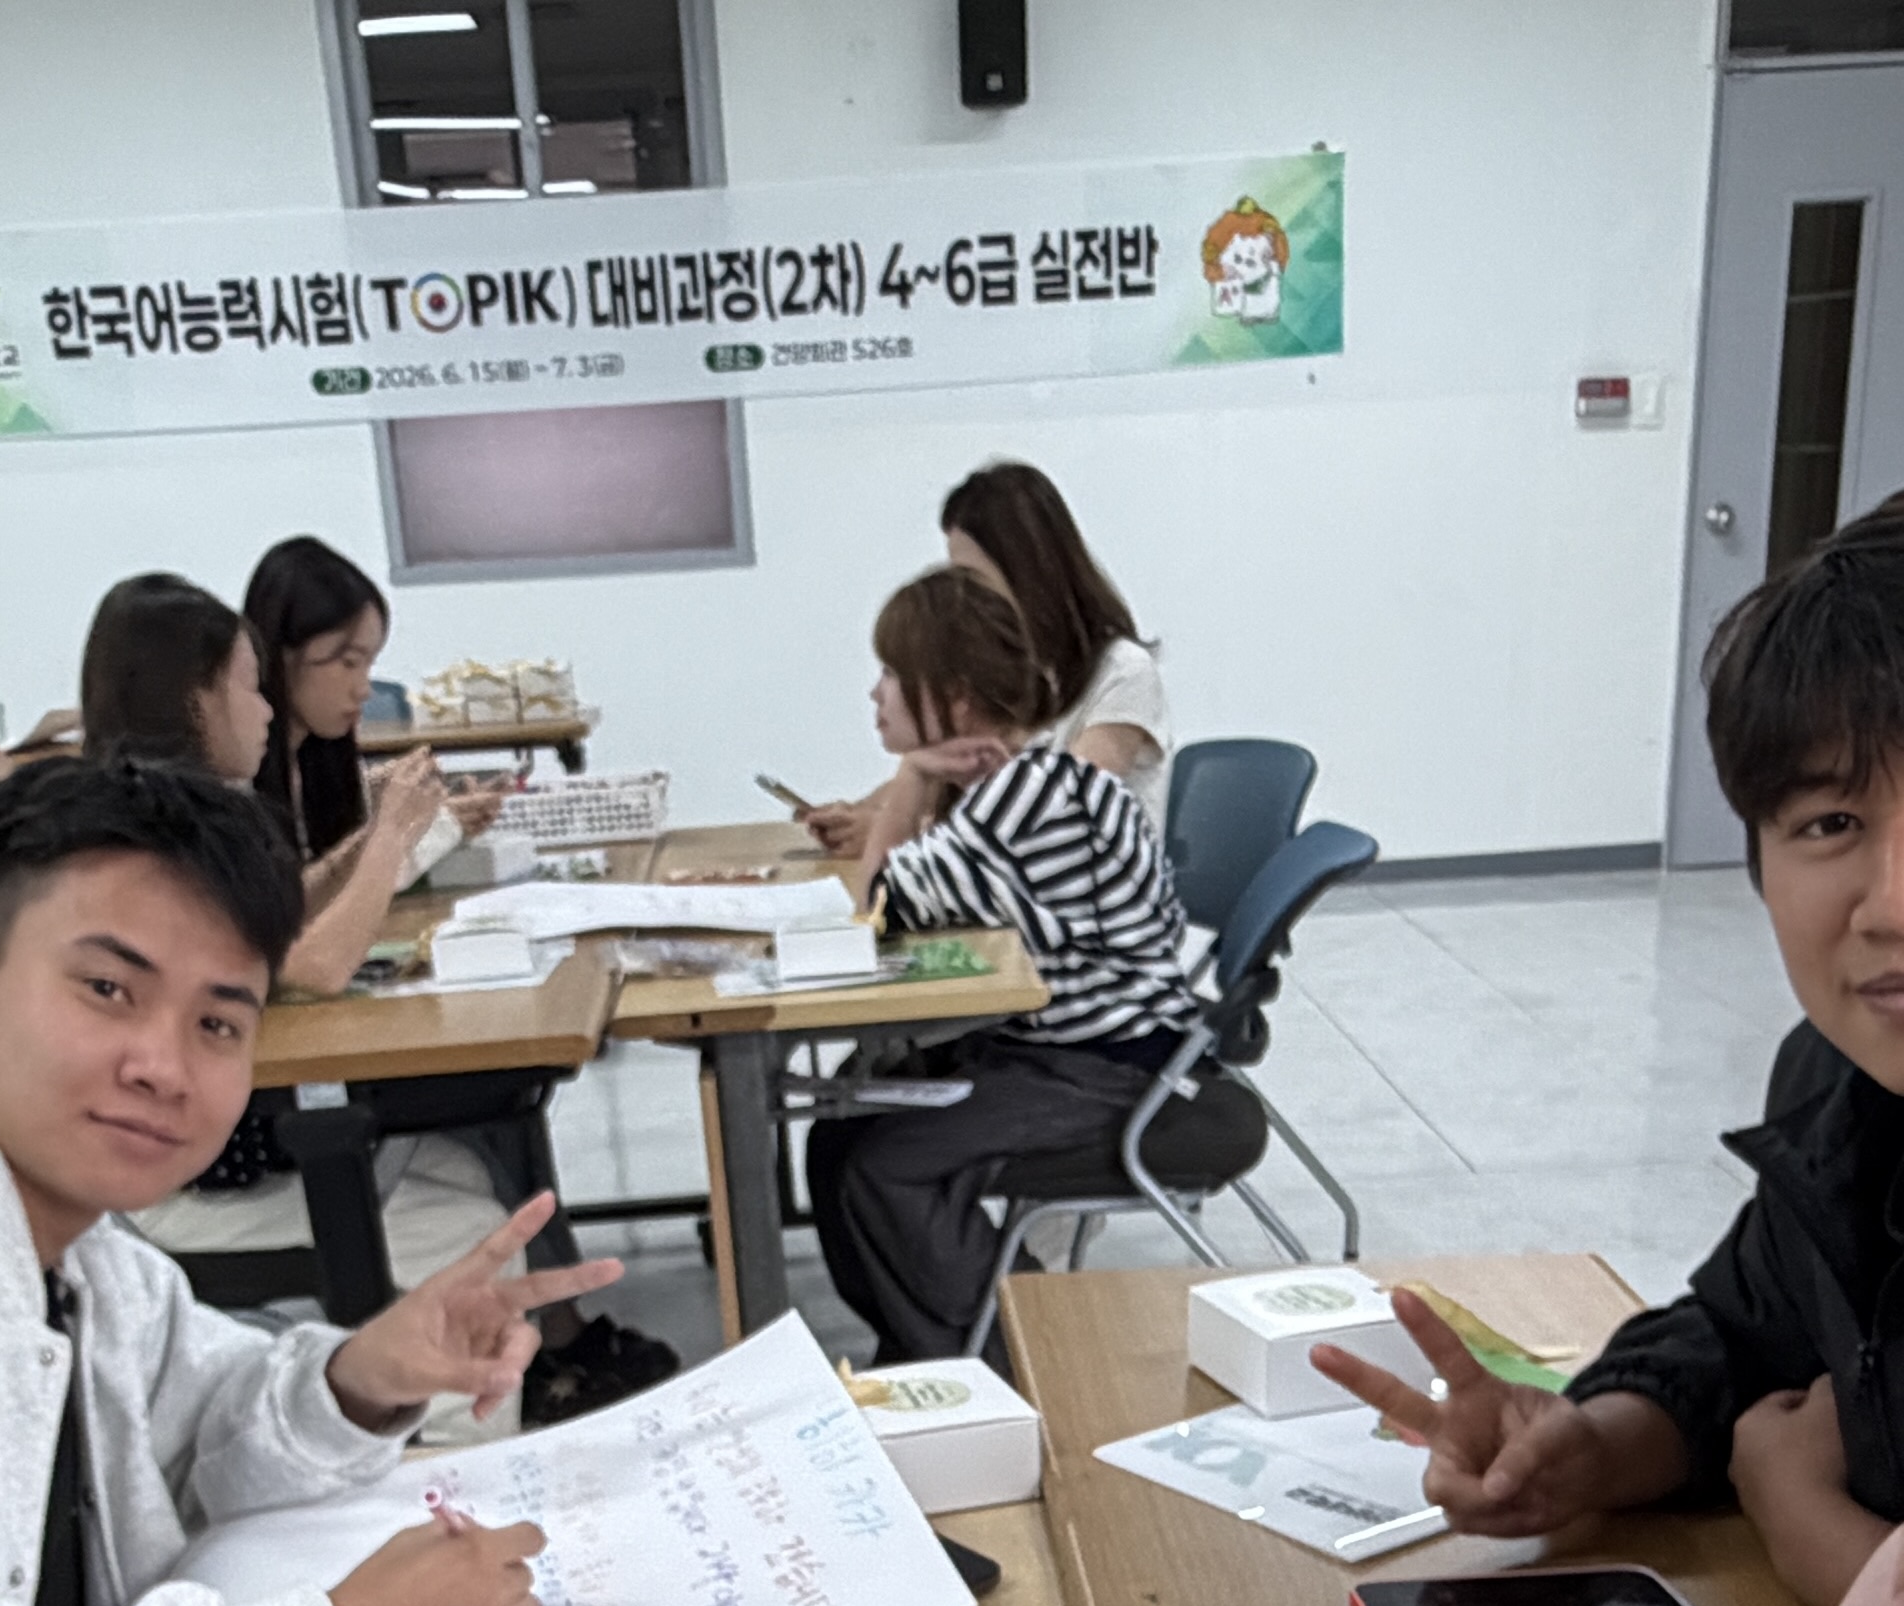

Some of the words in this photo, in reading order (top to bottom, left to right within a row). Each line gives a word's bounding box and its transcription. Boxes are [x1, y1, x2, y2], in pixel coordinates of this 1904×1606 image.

[42, 264, 578, 360] 한국어능력시험(TOPIK)
[586, 240, 867, 330] 대비과정(2차)
[878, 233, 1018, 310] 4~6급
[1031, 222, 1159, 303] 실전반
